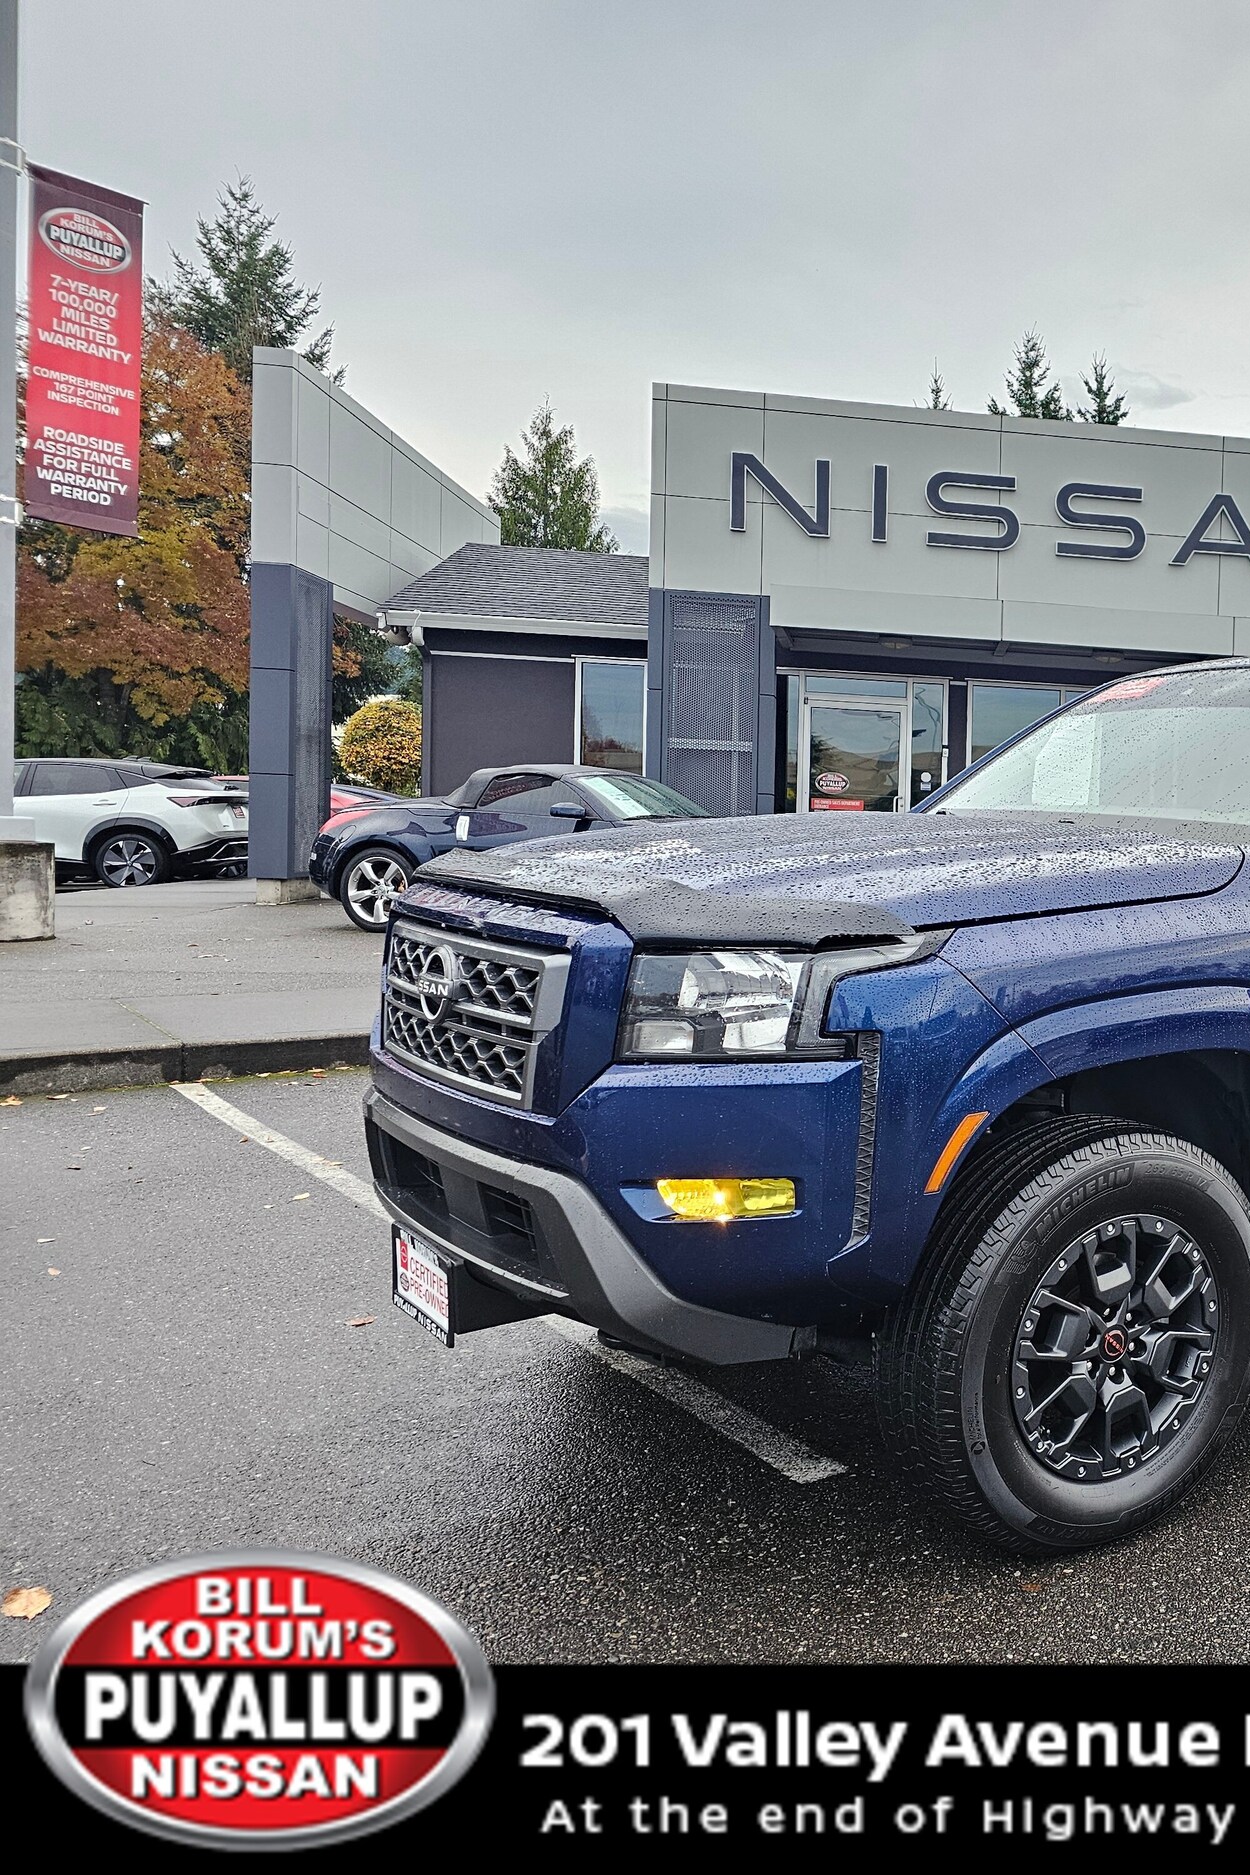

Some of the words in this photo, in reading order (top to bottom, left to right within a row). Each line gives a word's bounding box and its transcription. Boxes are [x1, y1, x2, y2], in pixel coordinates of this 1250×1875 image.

[60, 217, 114, 242] KORUM'S
[73, 213, 100, 229] BILL
[50, 224, 123, 260] PUYALLUP
[60, 244, 111, 267] NISSAN
[49, 289, 117, 318] 100,000
[50, 274, 119, 305] 7-YEAR/
[53, 318, 118, 347] LIMITED
[61, 306, 112, 330] MILES
[37, 328, 131, 365] WARRANTY
[33, 366, 135, 400] COMPREHENSIVE
[54, 382, 74, 394] 167
[77, 387, 115, 405] POINT
[47, 391, 120, 416] INSPECTION
[33, 438, 132, 471] ASSISTANCE
[43, 426, 125, 456] ROADSIDE
[36, 466, 129, 496] WARRANTY
[43, 454, 78, 473] FOR
[80, 462, 120, 481] FULL
[50, 484, 112, 506] PERIOD
[1036, 1167, 1131, 1239] MICHELIN
[418, 1311, 447, 1345] NISSAN
